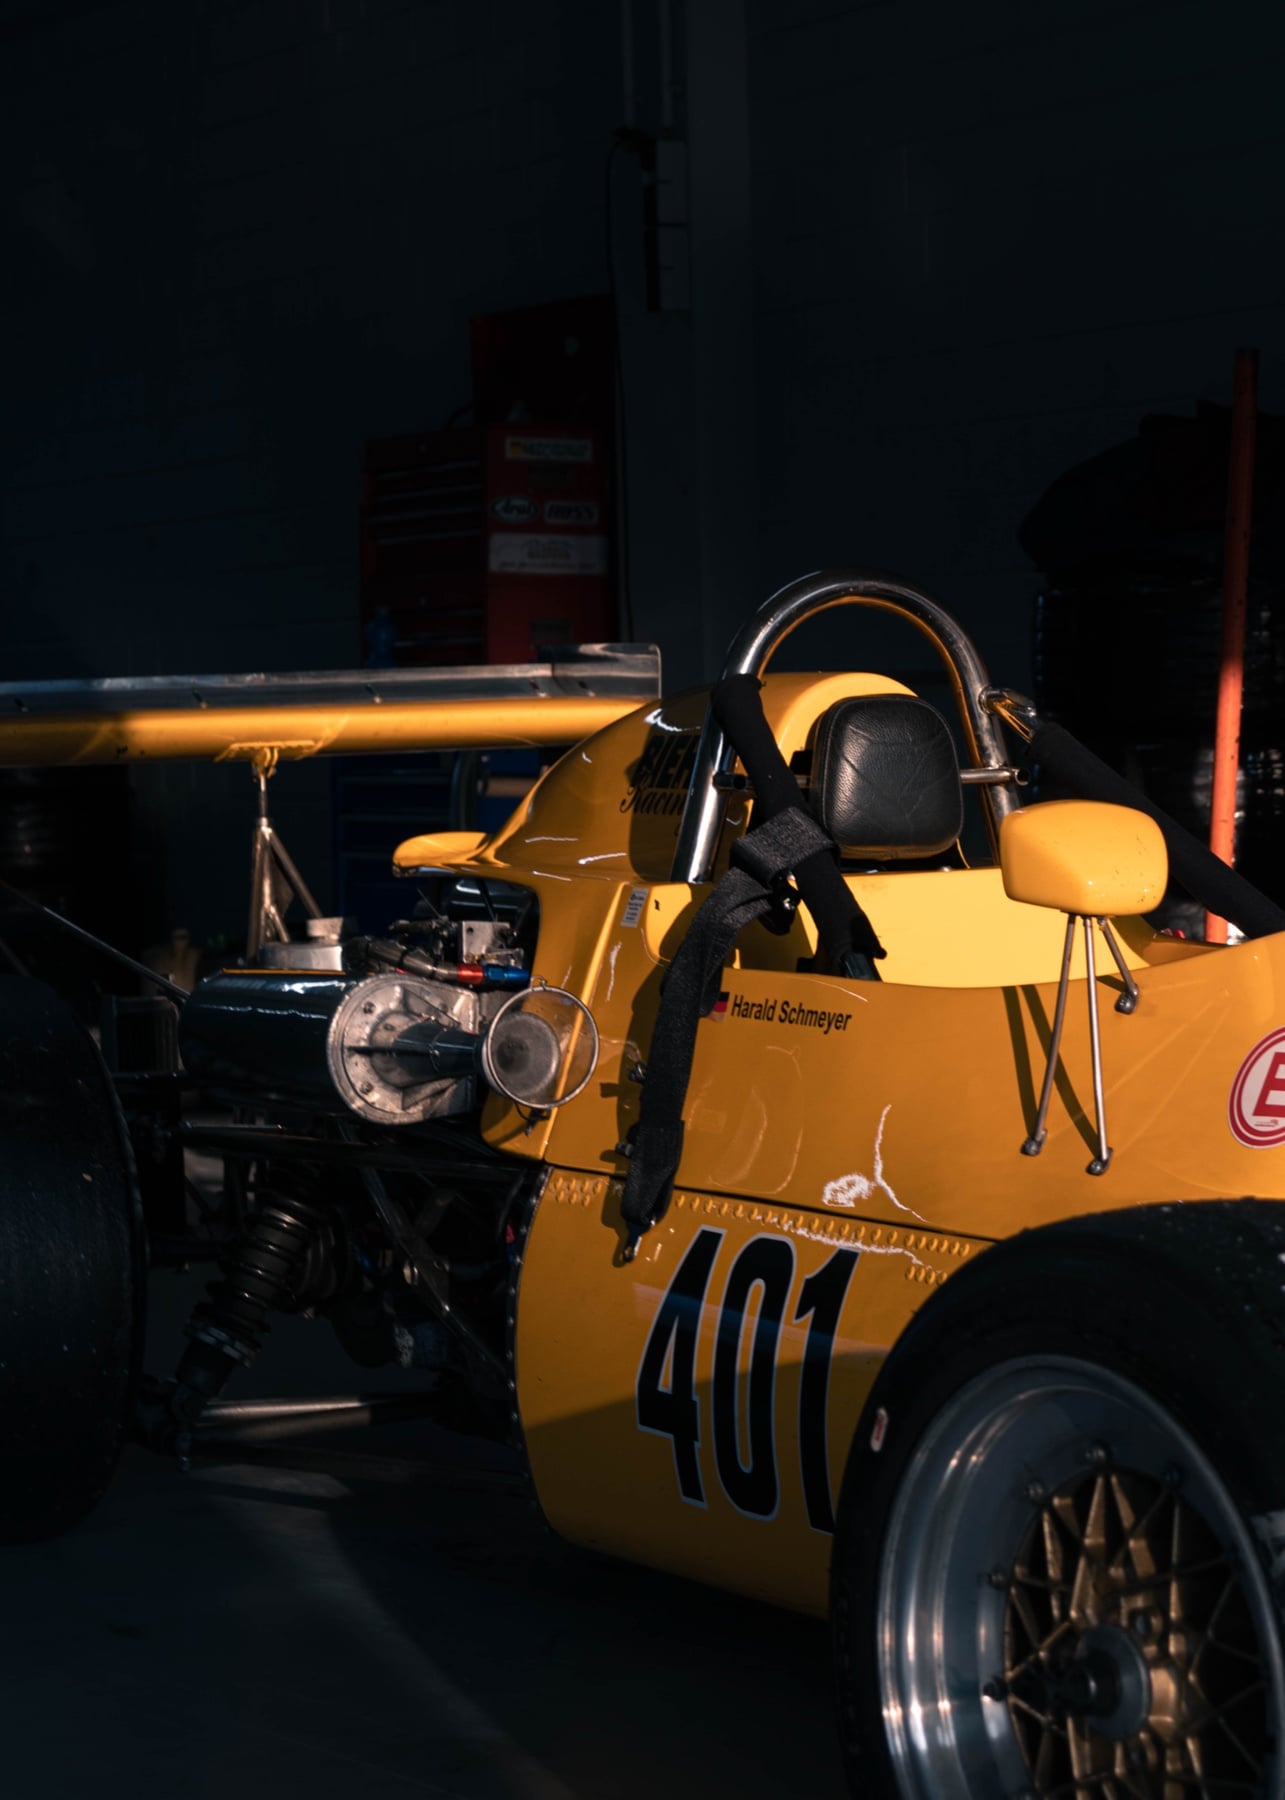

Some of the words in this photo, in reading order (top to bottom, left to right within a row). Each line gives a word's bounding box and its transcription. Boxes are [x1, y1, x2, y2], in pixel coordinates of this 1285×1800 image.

[619, 774, 686, 837] Racin
[731, 994, 778, 1021] Harald
[778, 1000, 853, 1035] Schmeyer
[636, 1225, 860, 1535] 401
